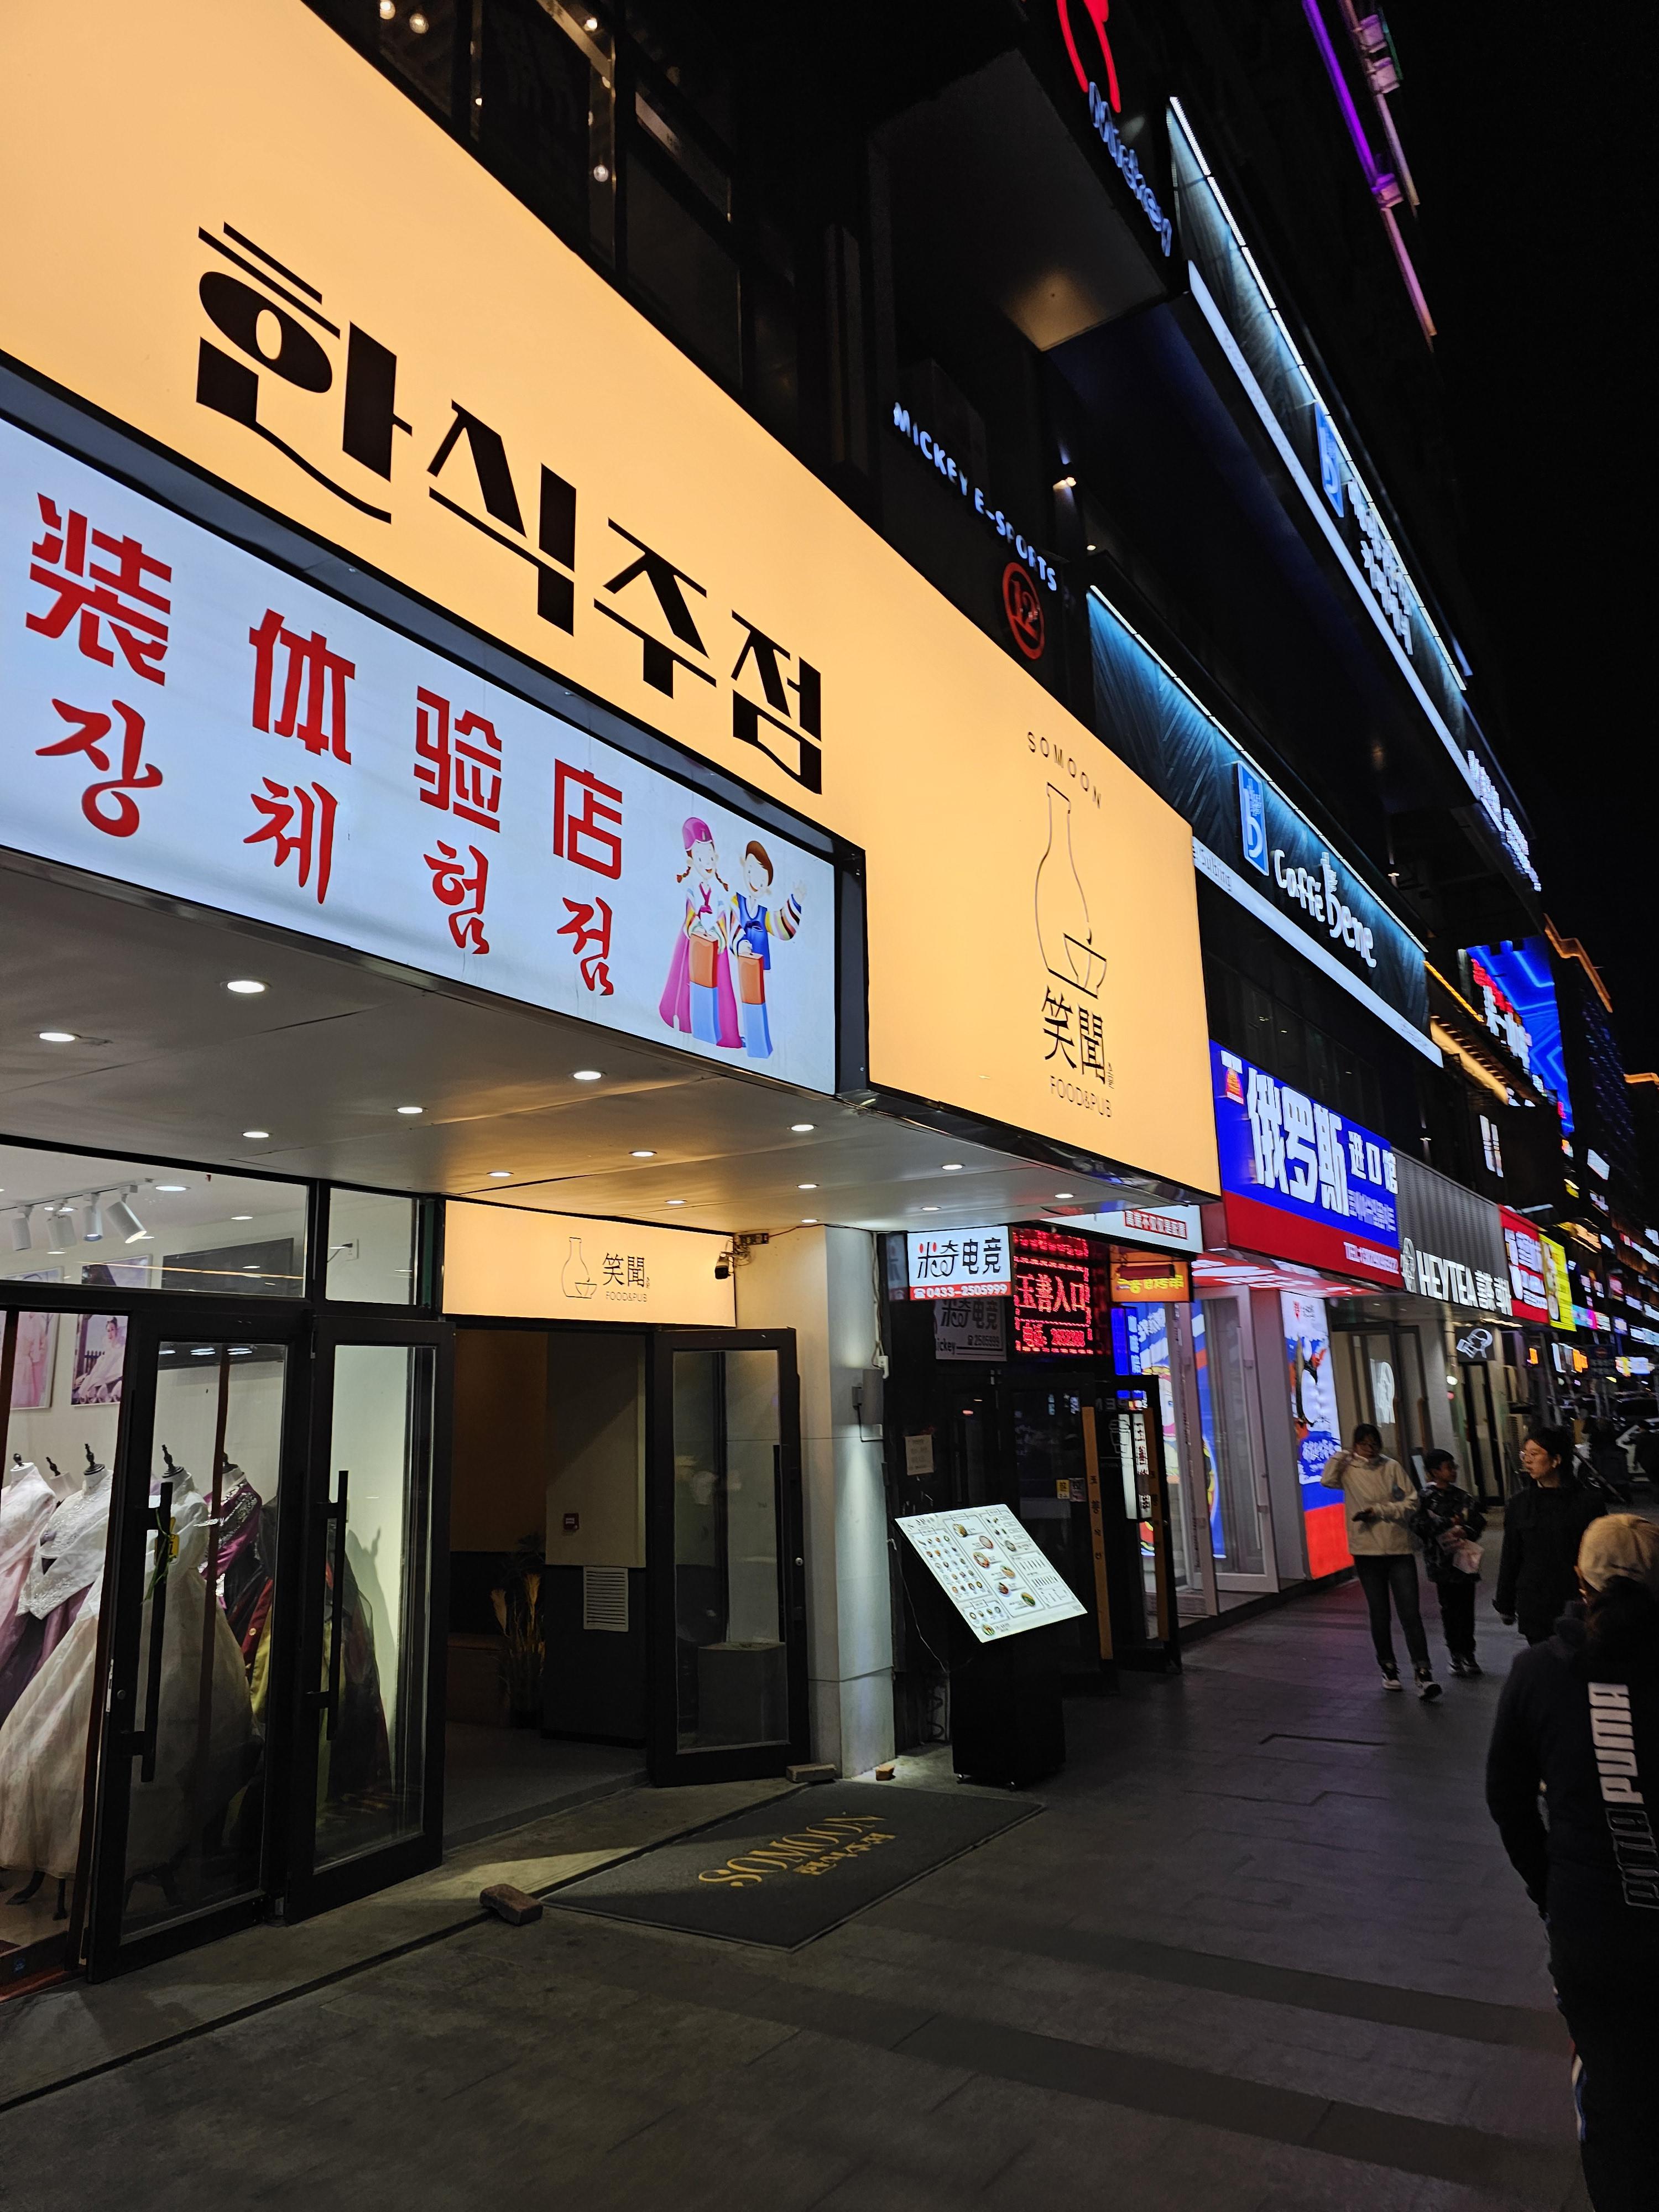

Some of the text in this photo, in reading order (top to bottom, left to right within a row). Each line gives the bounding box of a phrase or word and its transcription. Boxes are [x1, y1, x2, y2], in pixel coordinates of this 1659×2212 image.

[196, 222, 821, 795] 한식주점
[894, 402, 1057, 591] MICKEY E-SPORTS
[25, 492, 623, 880] 装体验店
[1027, 732, 1102, 810] SOMOON
[34, 698, 614, 996] 장체험점
[1041, 985, 1106, 1084] 笑聞
[1050, 1075, 1113, 1118] FOOD&PUB
[1348, 1130, 1399, 1194] 进口馆
[602, 1253, 645, 1288] 笑聞
[917, 1237, 1002, 1279] 米奇电竞
[926, 1284, 1008, 1298] 0433-2505999
[1415, 1250, 1479, 1308] HEYTEA
[606, 1291, 648, 1302] FOOD&PUB
[1587, 1681, 1645, 1804] PUMA
[698, 1815, 887, 1887] SOMOON
